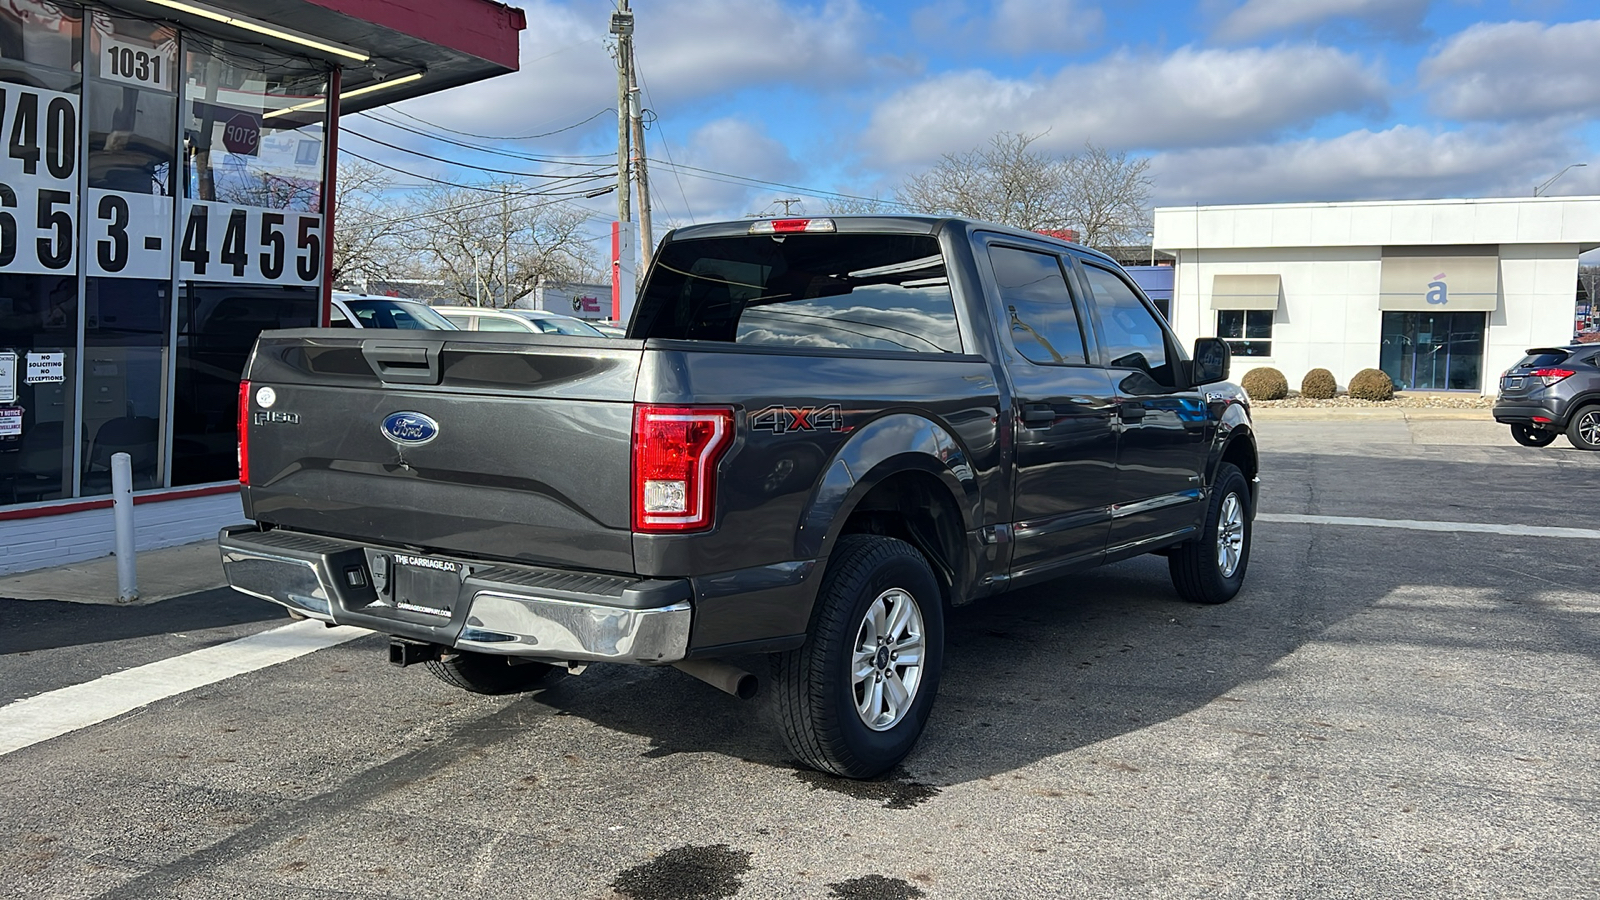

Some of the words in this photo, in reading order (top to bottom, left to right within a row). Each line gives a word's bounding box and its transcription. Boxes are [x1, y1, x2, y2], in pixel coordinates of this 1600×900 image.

[107, 45, 160, 84] 1031
[0, 88, 76, 180] 40
[392, 418, 424, 437] Ford
[394, 555, 409, 565] THE
[409, 556, 443, 569] CARRIAGE
